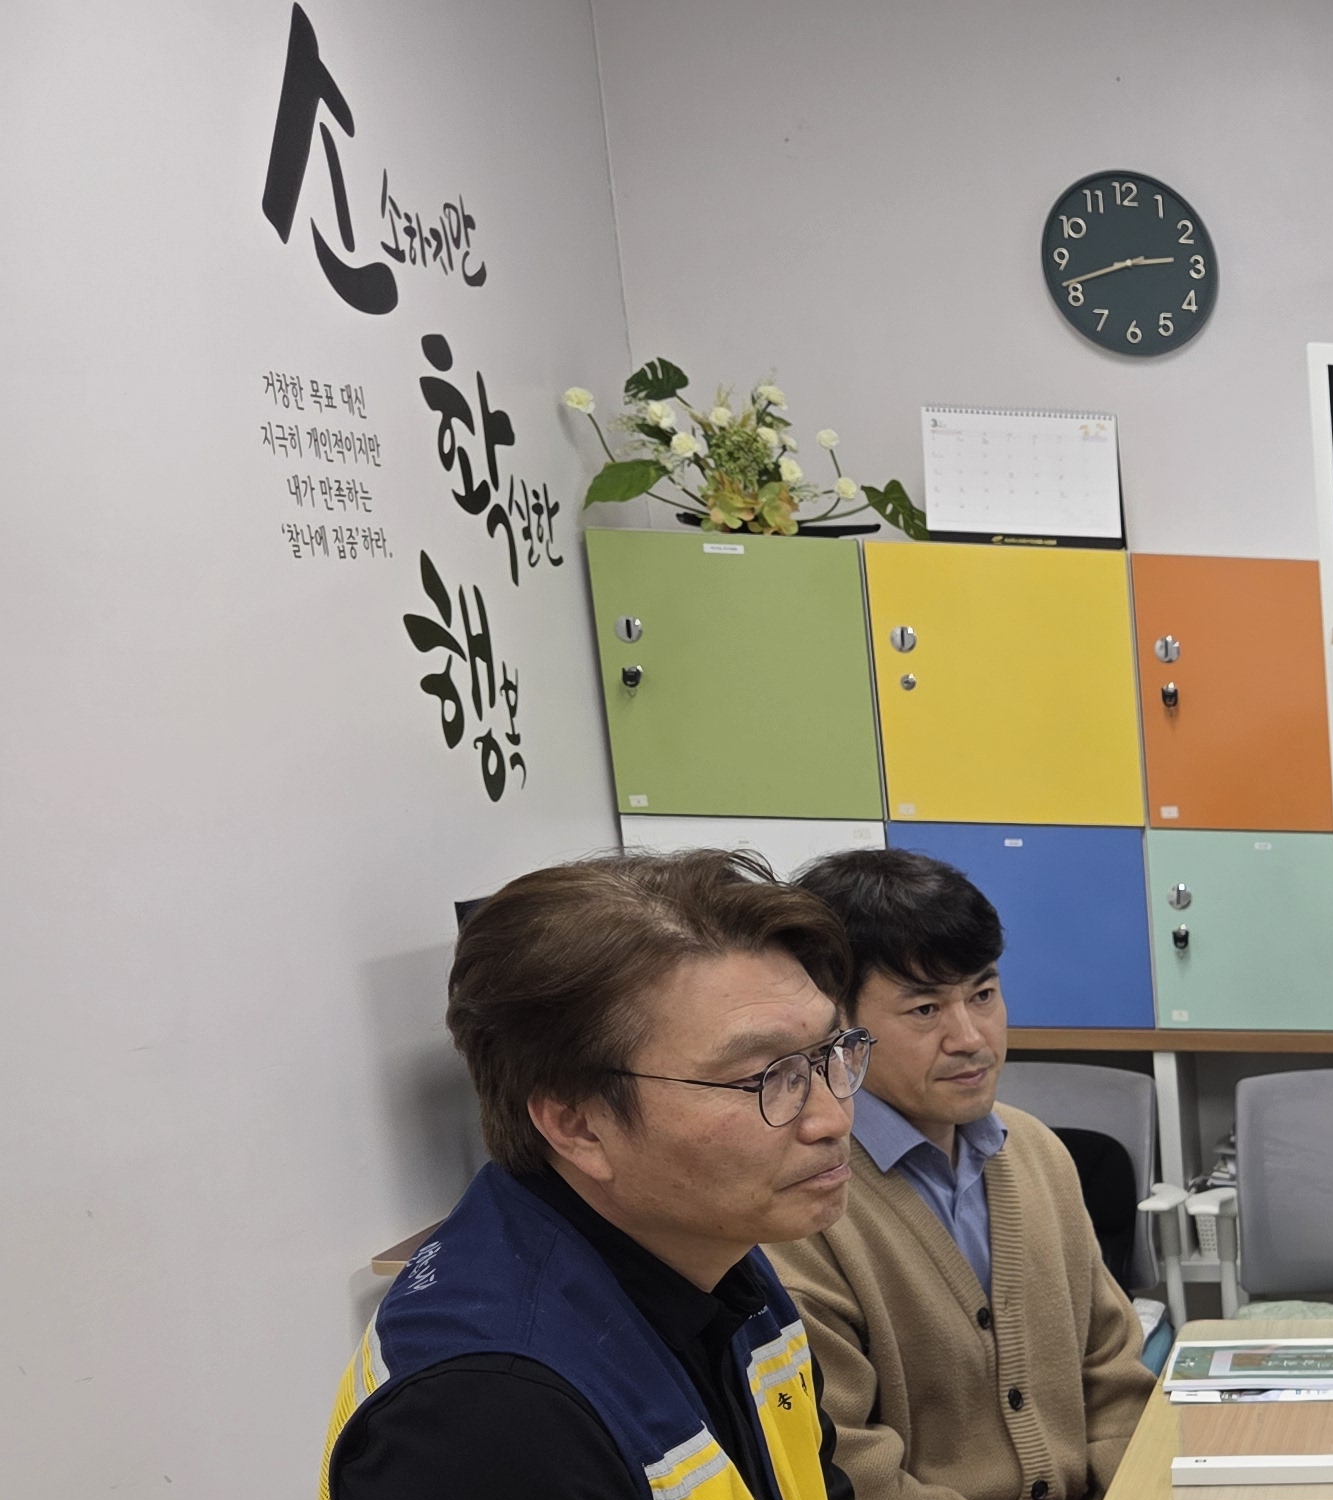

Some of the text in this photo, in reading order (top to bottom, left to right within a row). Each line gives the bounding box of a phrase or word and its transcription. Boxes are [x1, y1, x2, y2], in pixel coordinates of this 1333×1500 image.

[1082, 189, 1104, 214] 11
[1111, 182, 1139, 207] 12
[1153, 195, 1163, 219] 1
[1058, 215, 1087, 239] 10
[1177, 219, 1194, 244] 2
[1053, 247, 1069, 271] 9
[1189, 255, 1205, 279] 3
[1068, 282, 1084, 306] 8
[1181, 290, 1198, 313] 4
[1092, 309, 1109, 332] 7
[1126, 320, 1142, 343] 6
[1158, 312, 1174, 336] 5
[262, 371, 367, 419] 거창한 목표 대신
[261, 421, 381, 467] 지극히 개인적이지만
[287, 475, 372, 512] 내가 만족하는
